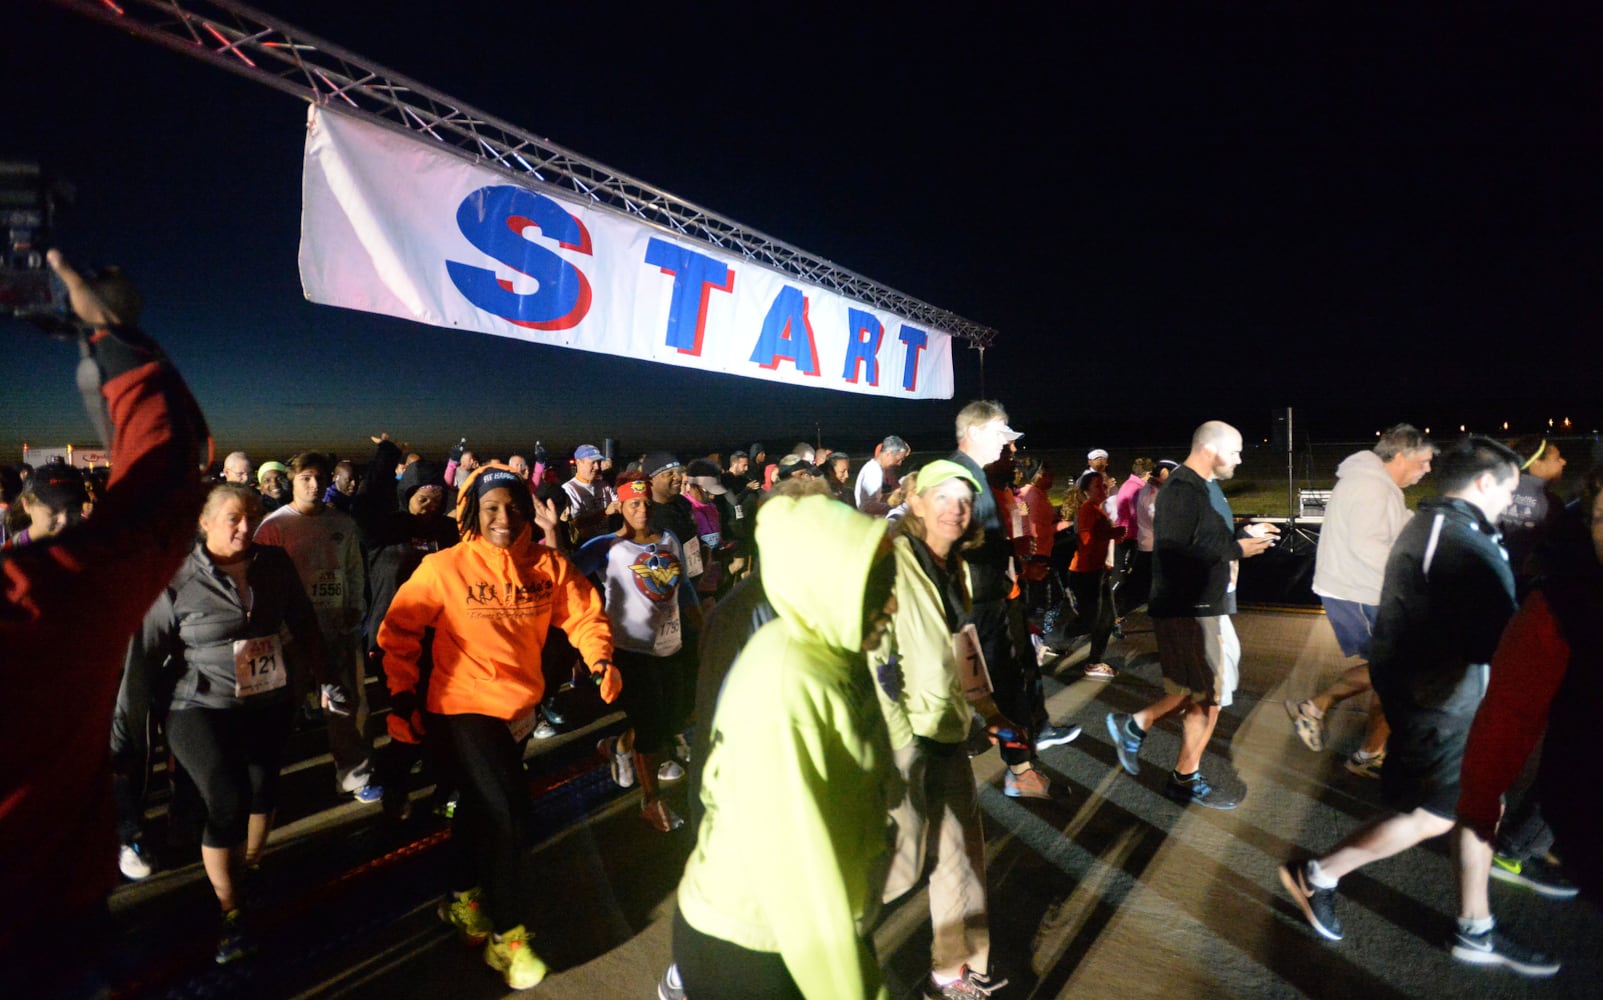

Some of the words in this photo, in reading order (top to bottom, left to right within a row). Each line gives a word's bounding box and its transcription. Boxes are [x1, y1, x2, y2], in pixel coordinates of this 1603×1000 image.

[446, 185, 928, 392] START
[311, 582, 342, 597] 1556
[247, 654, 276, 677] 121
